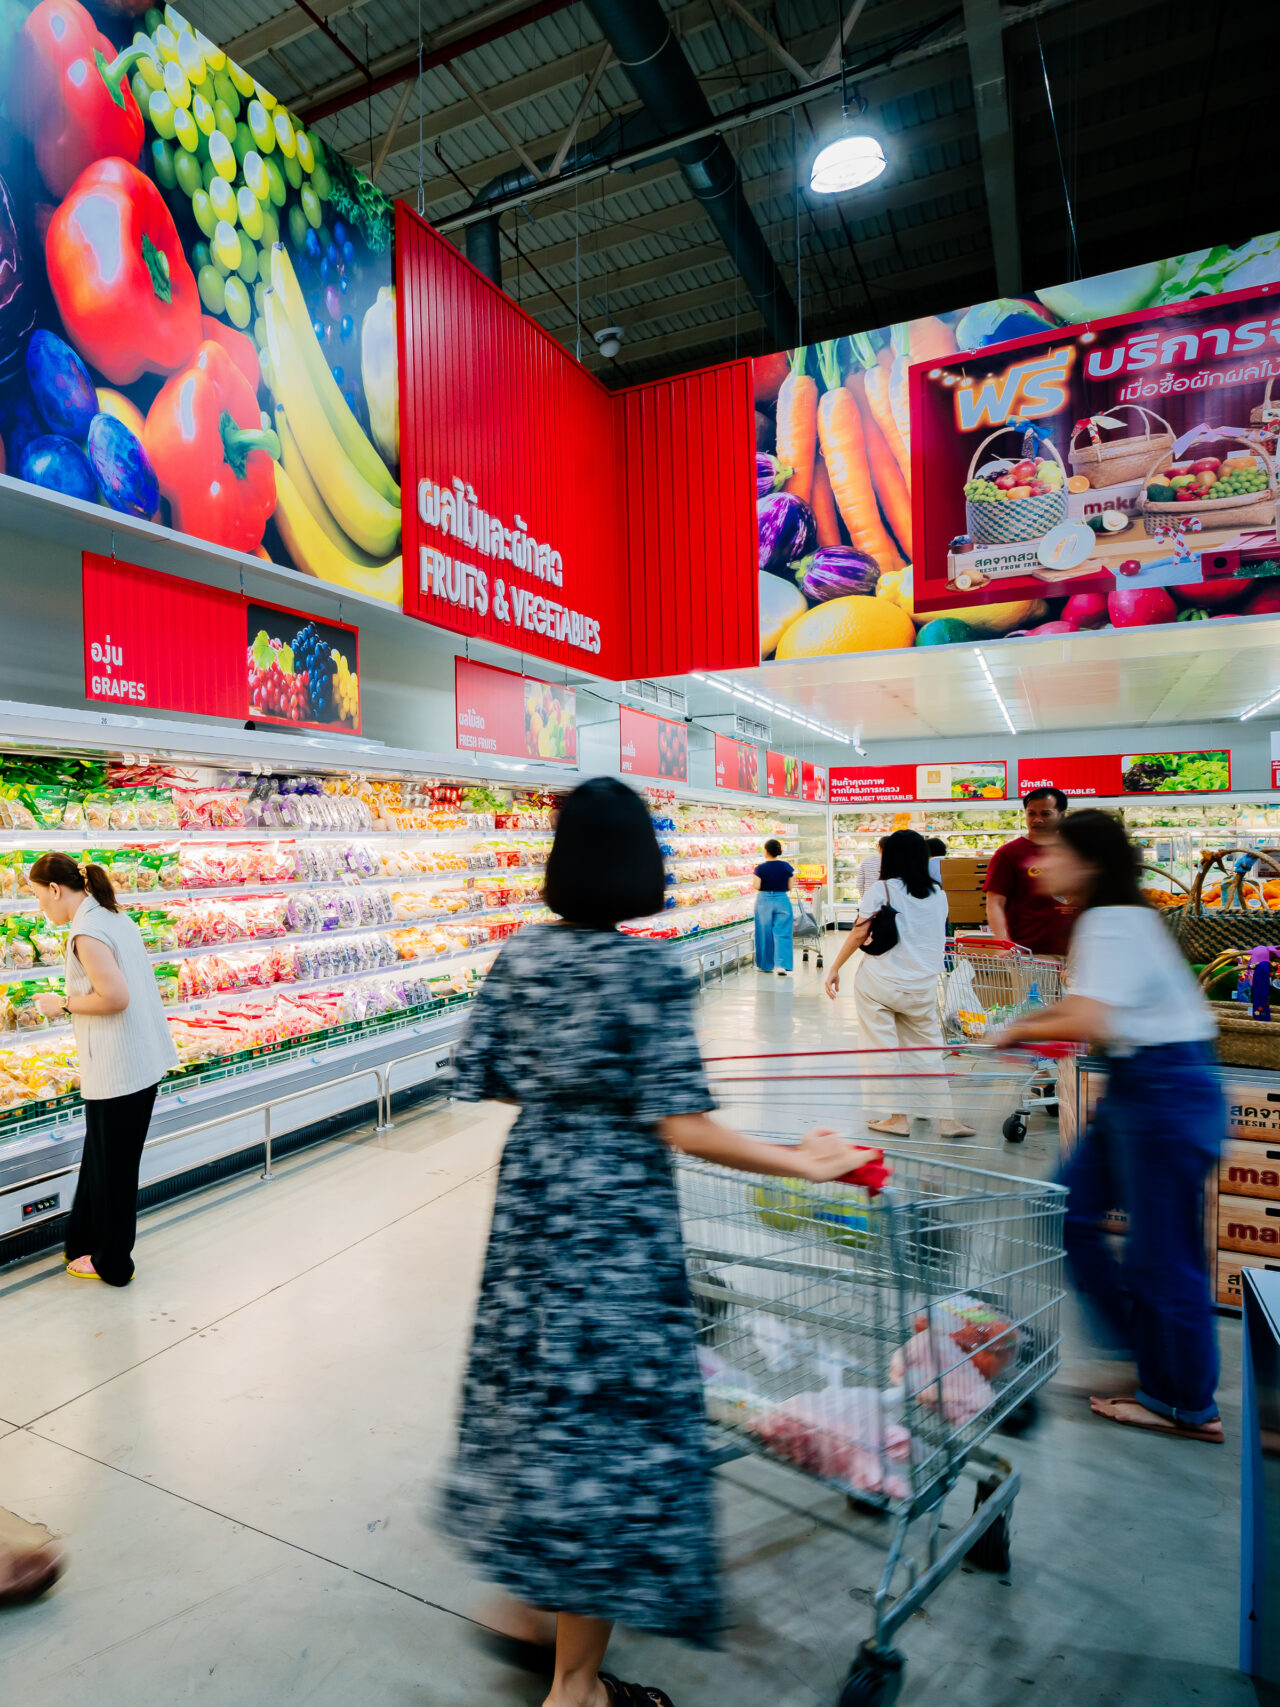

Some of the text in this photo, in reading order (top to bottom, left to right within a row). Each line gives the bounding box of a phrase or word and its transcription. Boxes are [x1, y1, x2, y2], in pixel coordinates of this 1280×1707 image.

[1087, 317, 1280, 378] บริการ
[957, 349, 1072, 429] ฟรี
[1083, 495, 1138, 516] makr
[417, 474, 563, 588] ผลไม้และผักสด
[419, 546, 601, 655] FRUITS & VEGETABLES
[90, 634, 123, 674] องุ่น
[91, 675, 146, 700] GRAPES
[459, 733, 497, 751] FRESH FRUITS
[831, 777, 885, 787] สินค้าคุณภาพ
[831, 785, 900, 794] จากโครงการหลวง
[1020, 779, 1054, 788] ผักสลัด
[1230, 1118, 1267, 1129] FRESH
[1227, 1221, 1280, 1245] ma
